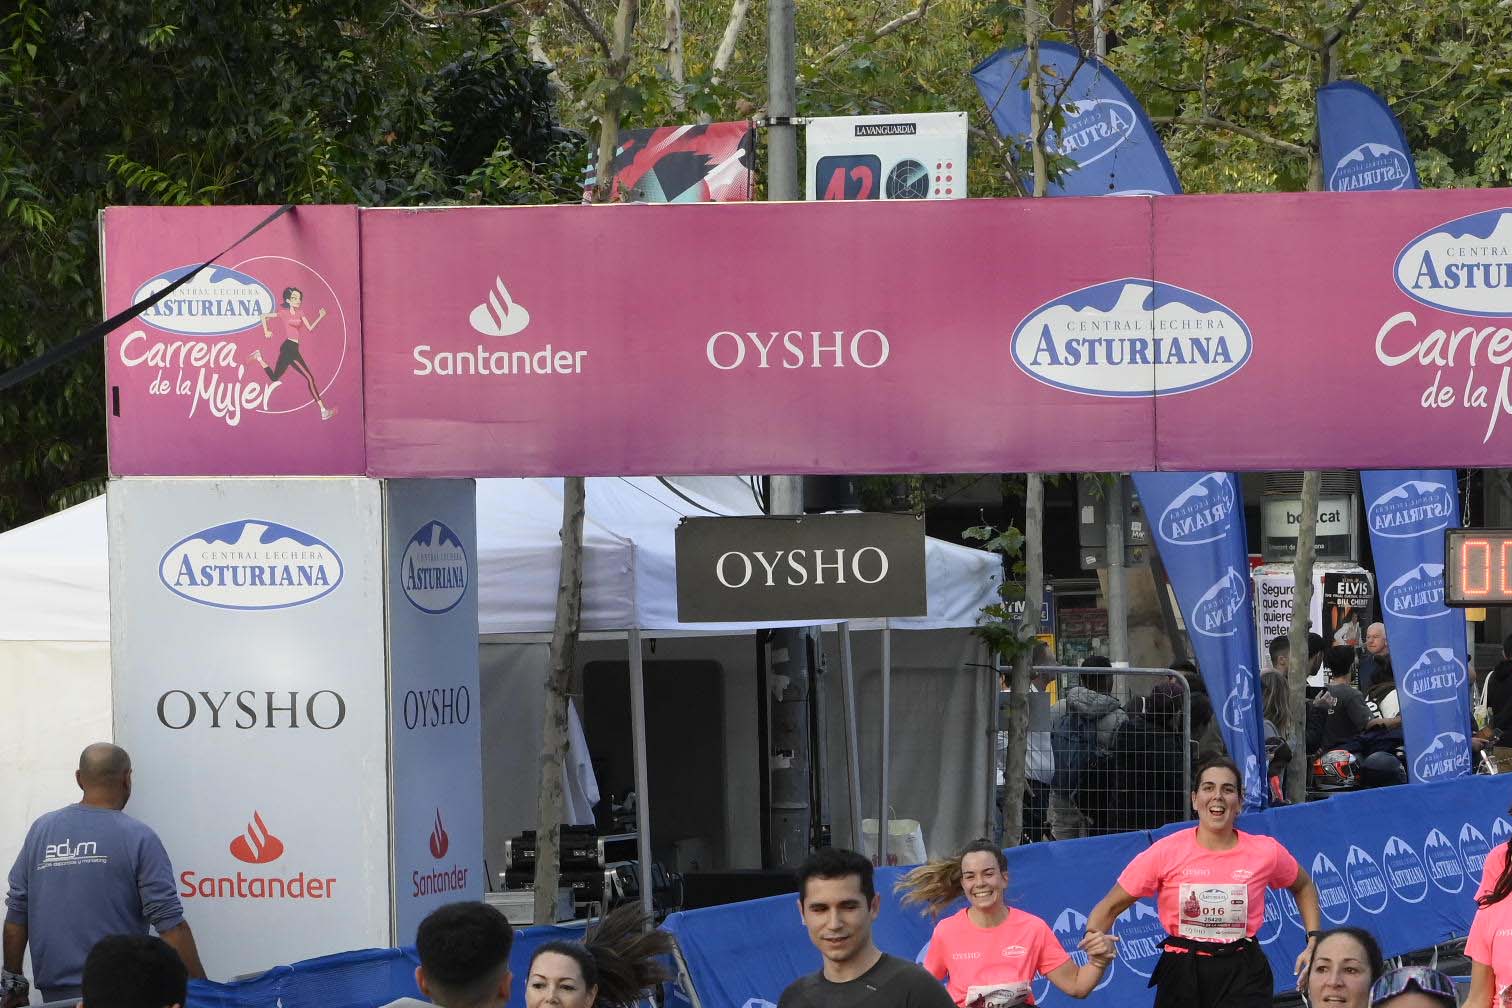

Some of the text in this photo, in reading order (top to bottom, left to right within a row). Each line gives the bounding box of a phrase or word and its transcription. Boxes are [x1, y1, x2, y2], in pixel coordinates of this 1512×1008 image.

[213, 288, 260, 296] LECHERA
[1066, 318, 1226, 331] CENTRAL LECHERA
[119, 331, 238, 368] Carrera
[412, 344, 588, 377] Santander
[706, 329, 890, 370] OYSHO
[1029, 322, 1234, 368] ASTURIANA
[149, 370, 192, 395] de la
[189, 364, 283, 427] Mujer
[1420, 368, 1489, 408] de la
[174, 553, 330, 587] ASTURIANA
[201, 551, 323, 561] CENTRAL LECHERA
[716, 546, 889, 588] OYSHO
[407, 556, 464, 592] ASTURIANA
[1337, 582, 1368, 595] ELVIS
[1262, 600, 1279, 611] que
[157, 689, 346, 730] OYSHO
[404, 685, 470, 730] OYSHO
[46, 838, 97, 859] edym
[180, 870, 336, 899] Santander
[412, 865, 468, 898] Santander
[1202, 907, 1225, 916] 016
